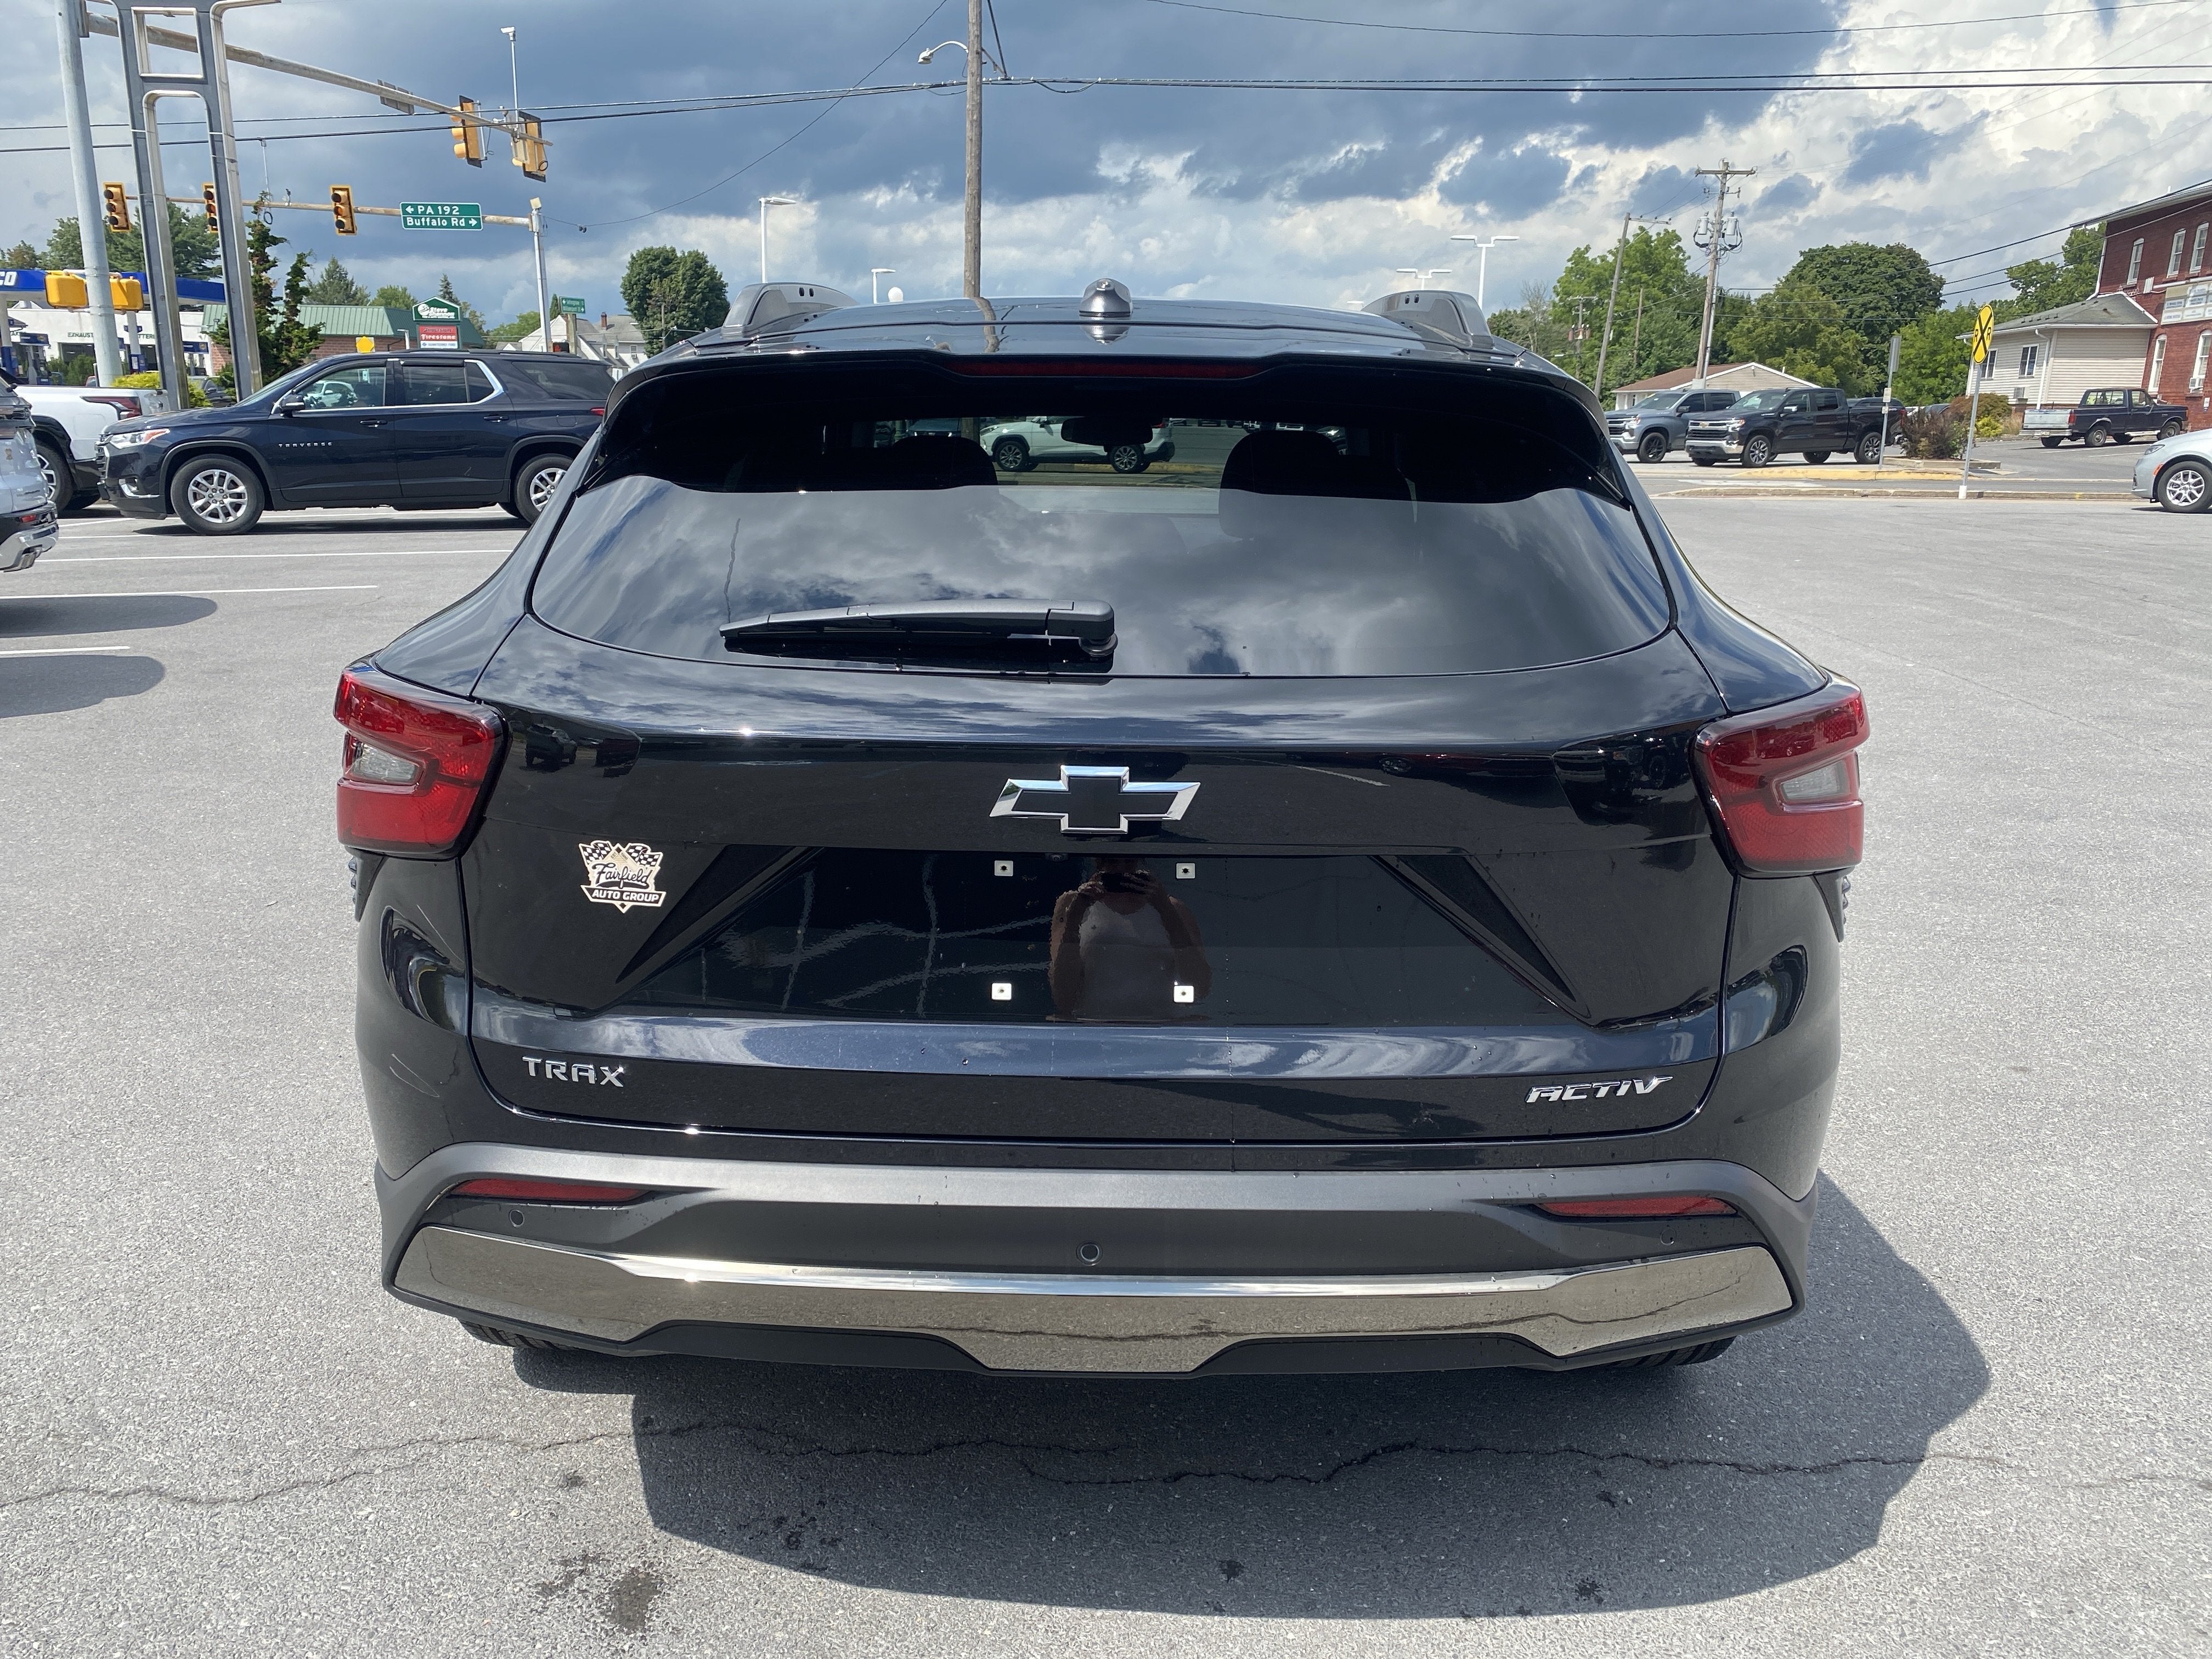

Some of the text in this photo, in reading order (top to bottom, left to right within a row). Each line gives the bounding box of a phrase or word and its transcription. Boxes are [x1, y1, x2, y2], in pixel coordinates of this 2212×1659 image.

[417, 205, 459, 215] PA 192
[407, 217, 465, 227] Buffalo Rd
[1974, 327, 1991, 342] R R
[591, 862, 653, 886] Fairfield
[592, 889, 659, 902] AUTO GROUP
[522, 1056, 624, 1087] TRAX
[1525, 1075, 1673, 1103] ACTIV
